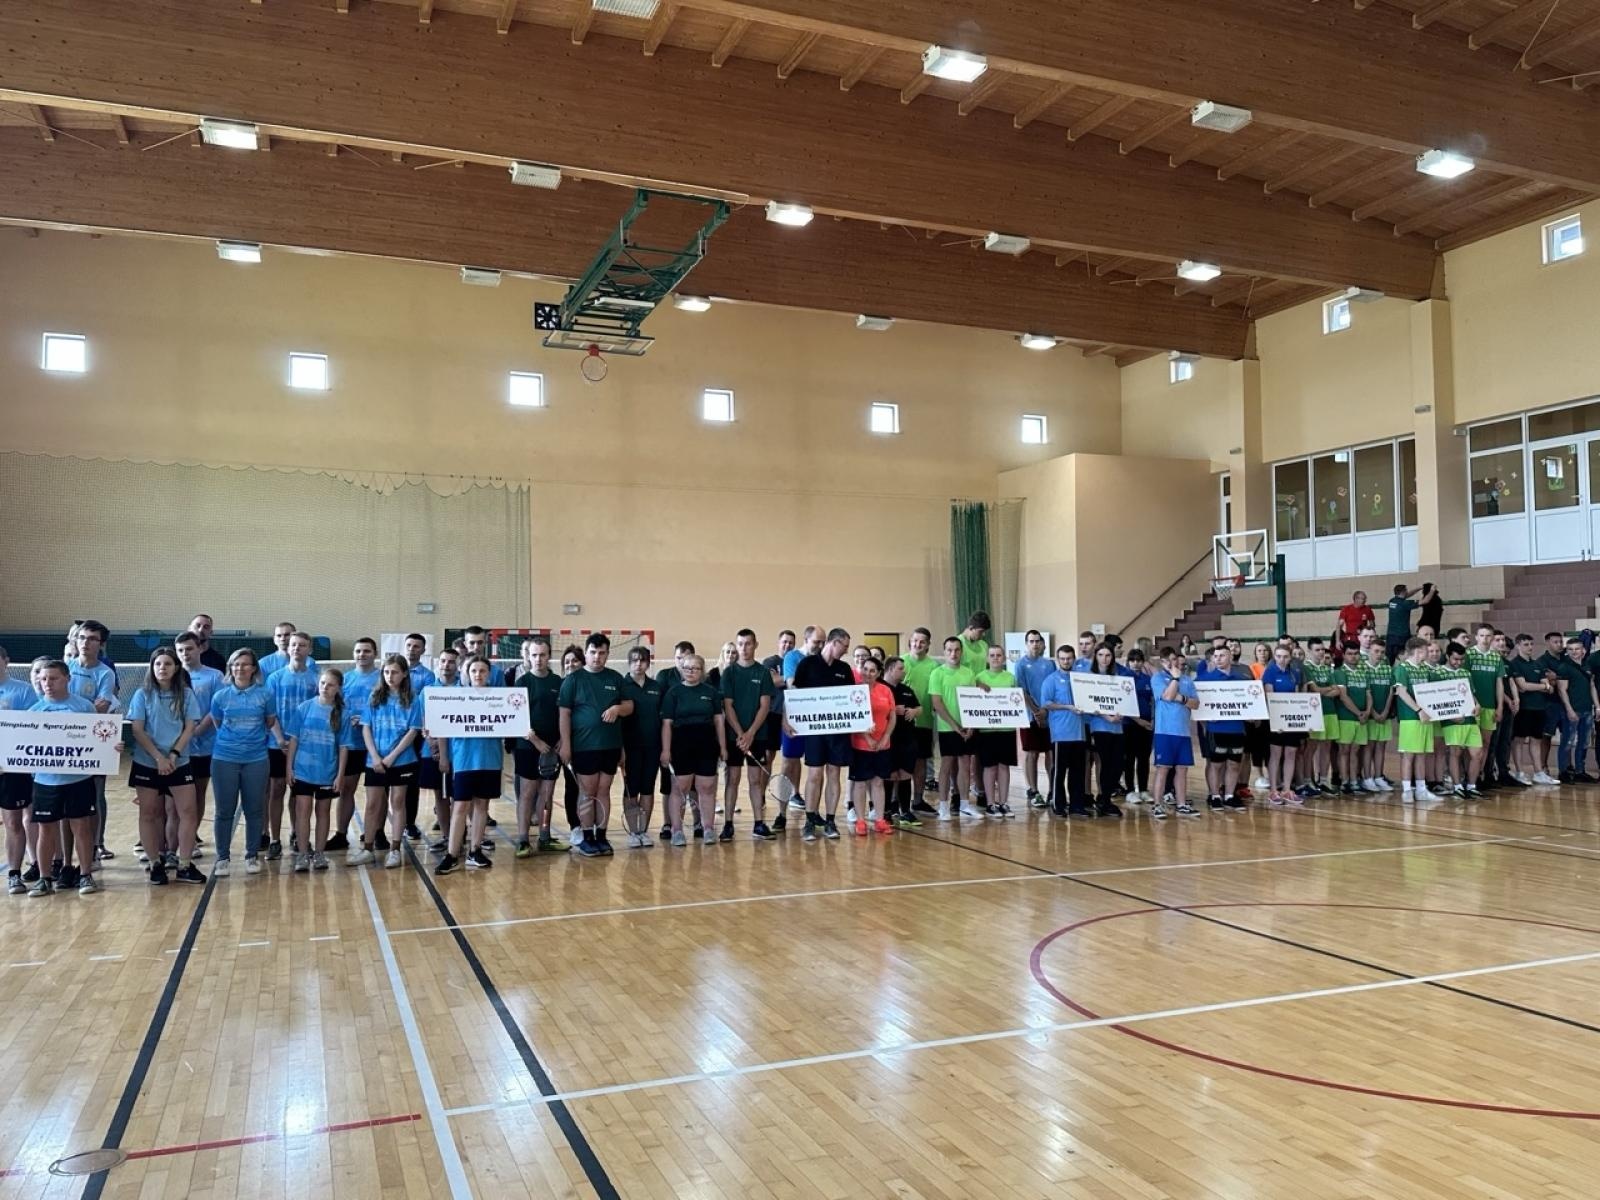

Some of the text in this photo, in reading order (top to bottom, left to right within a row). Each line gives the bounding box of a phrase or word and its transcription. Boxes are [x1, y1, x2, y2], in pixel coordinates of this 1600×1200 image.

[789, 710, 871, 723] "HALEMBIANKA"
[963, 709, 1024, 717] "KONICZYNKA"
[441, 714, 516, 724] "FAIR PLAY"
[0, 721, 40, 730] limpiady
[464, 724, 494, 732] RYBNIK
[15, 744, 95, 757] "CHABRY"
[6, 757, 101, 770] WODZISŁAW ŚLĄSKI
